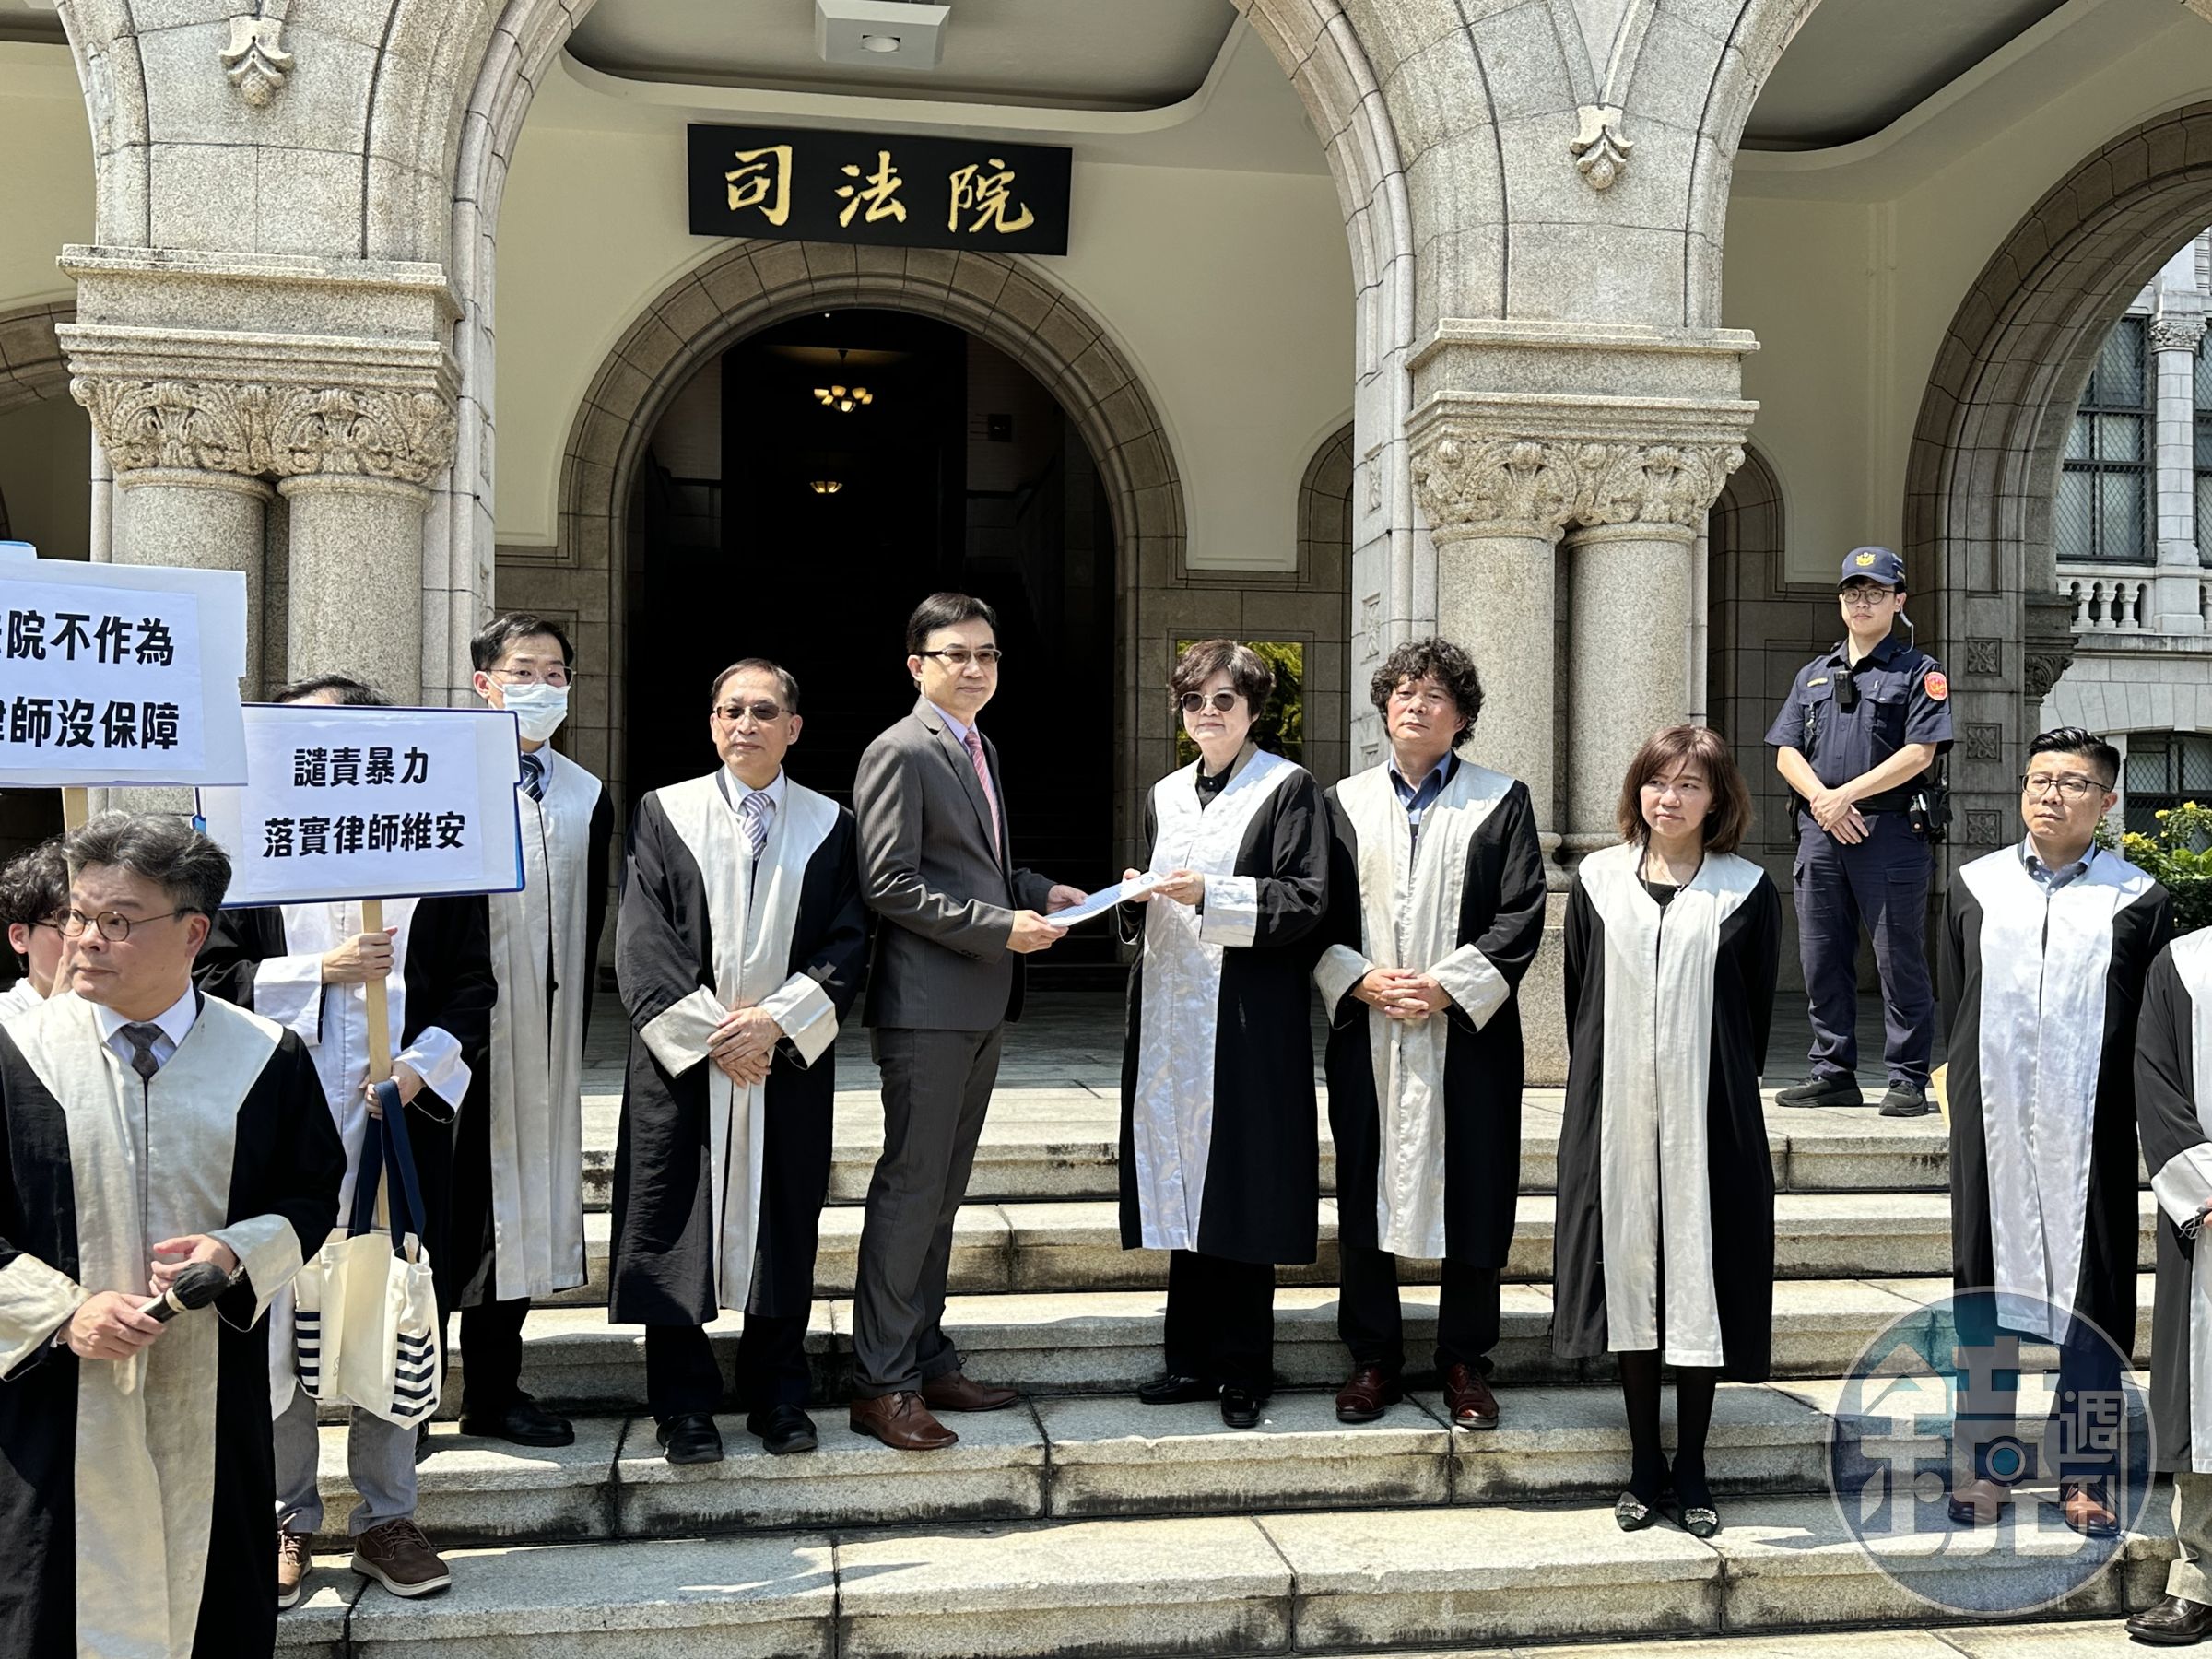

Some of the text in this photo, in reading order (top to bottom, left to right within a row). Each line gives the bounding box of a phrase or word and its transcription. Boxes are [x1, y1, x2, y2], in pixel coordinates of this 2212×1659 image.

[724, 144, 1035, 234] 司法院
[0, 610, 174, 666] 院不作為
[0, 696, 180, 750] 師沒保障
[293, 746, 429, 787] 譴責暴力
[262, 810, 465, 858] 落實律師維安
